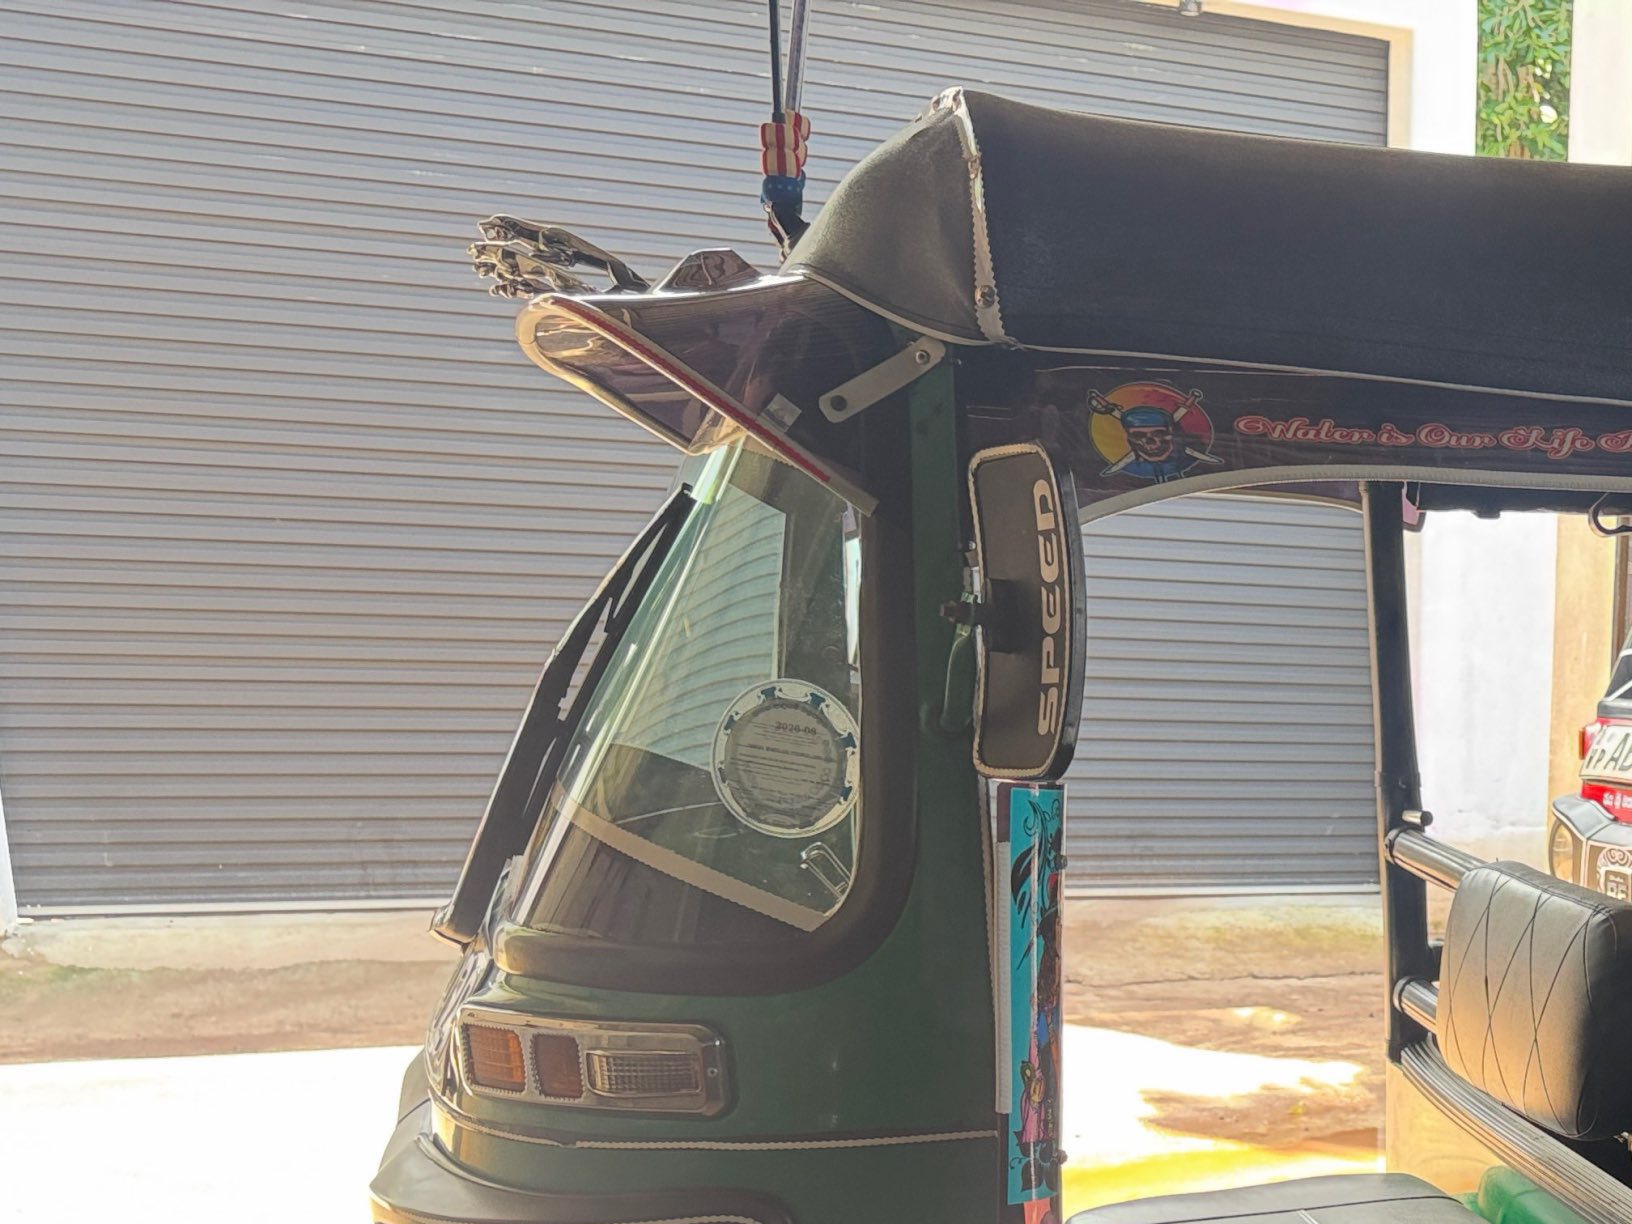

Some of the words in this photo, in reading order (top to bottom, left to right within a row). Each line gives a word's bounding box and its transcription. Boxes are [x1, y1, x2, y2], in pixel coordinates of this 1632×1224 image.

[1234, 415, 1375, 444] Water
[1377, 422, 1415, 446] is
[1416, 422, 1497, 449] Our
[1499, 426, 1594, 459] Life
[1032, 478, 1062, 736] SPEED
